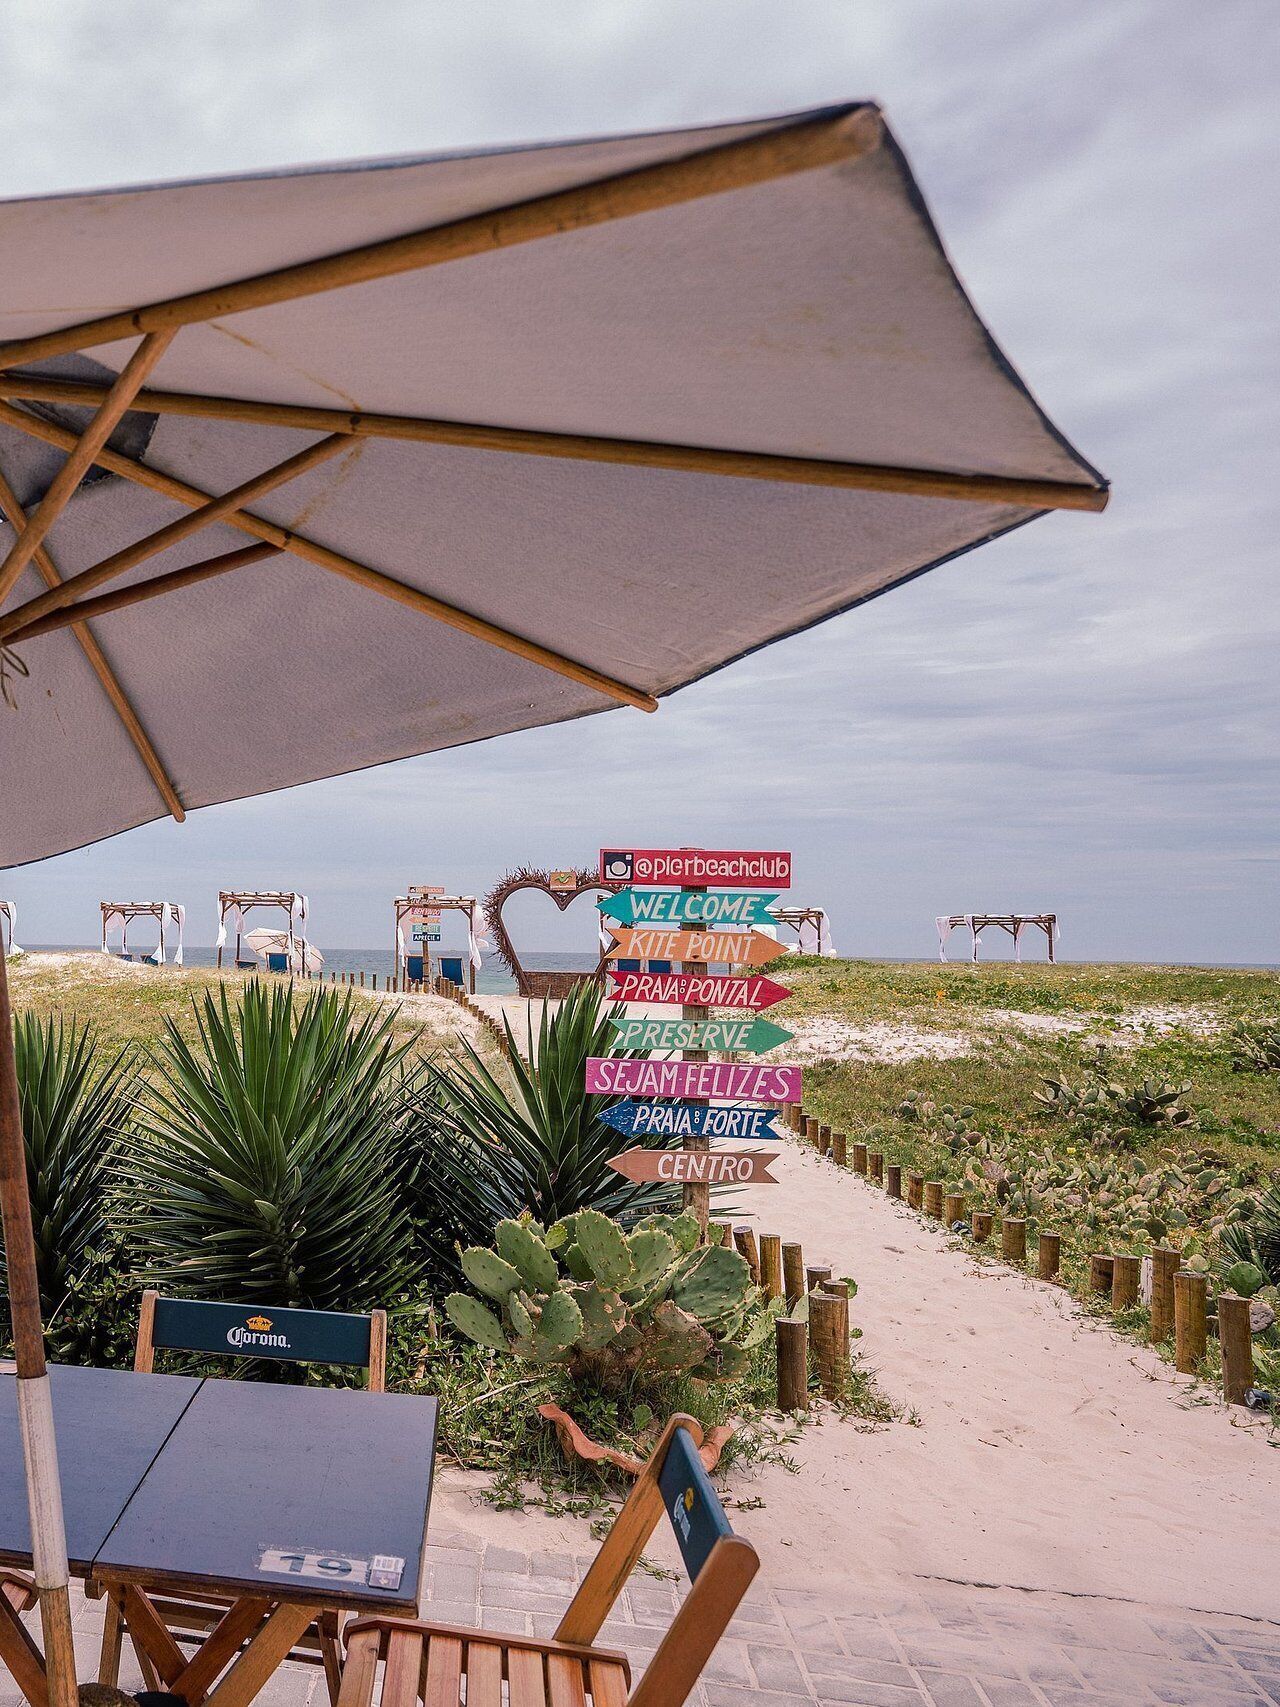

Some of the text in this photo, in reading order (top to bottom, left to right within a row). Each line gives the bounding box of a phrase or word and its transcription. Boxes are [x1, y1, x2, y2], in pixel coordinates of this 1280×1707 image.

[630, 894, 761, 921] WELCOME
[627, 932, 757, 961] KITE POINT
[620, 974, 682, 1001] PRAIA
[684, 978, 763, 1006] PONTAL
[623, 1022, 754, 1049] PRESERVE
[632, 1105, 693, 1134] PRAIA
[701, 1109, 766, 1137] FORTE
[658, 1154, 754, 1180] CENTRO
[280, 1554, 352, 1578] 19
